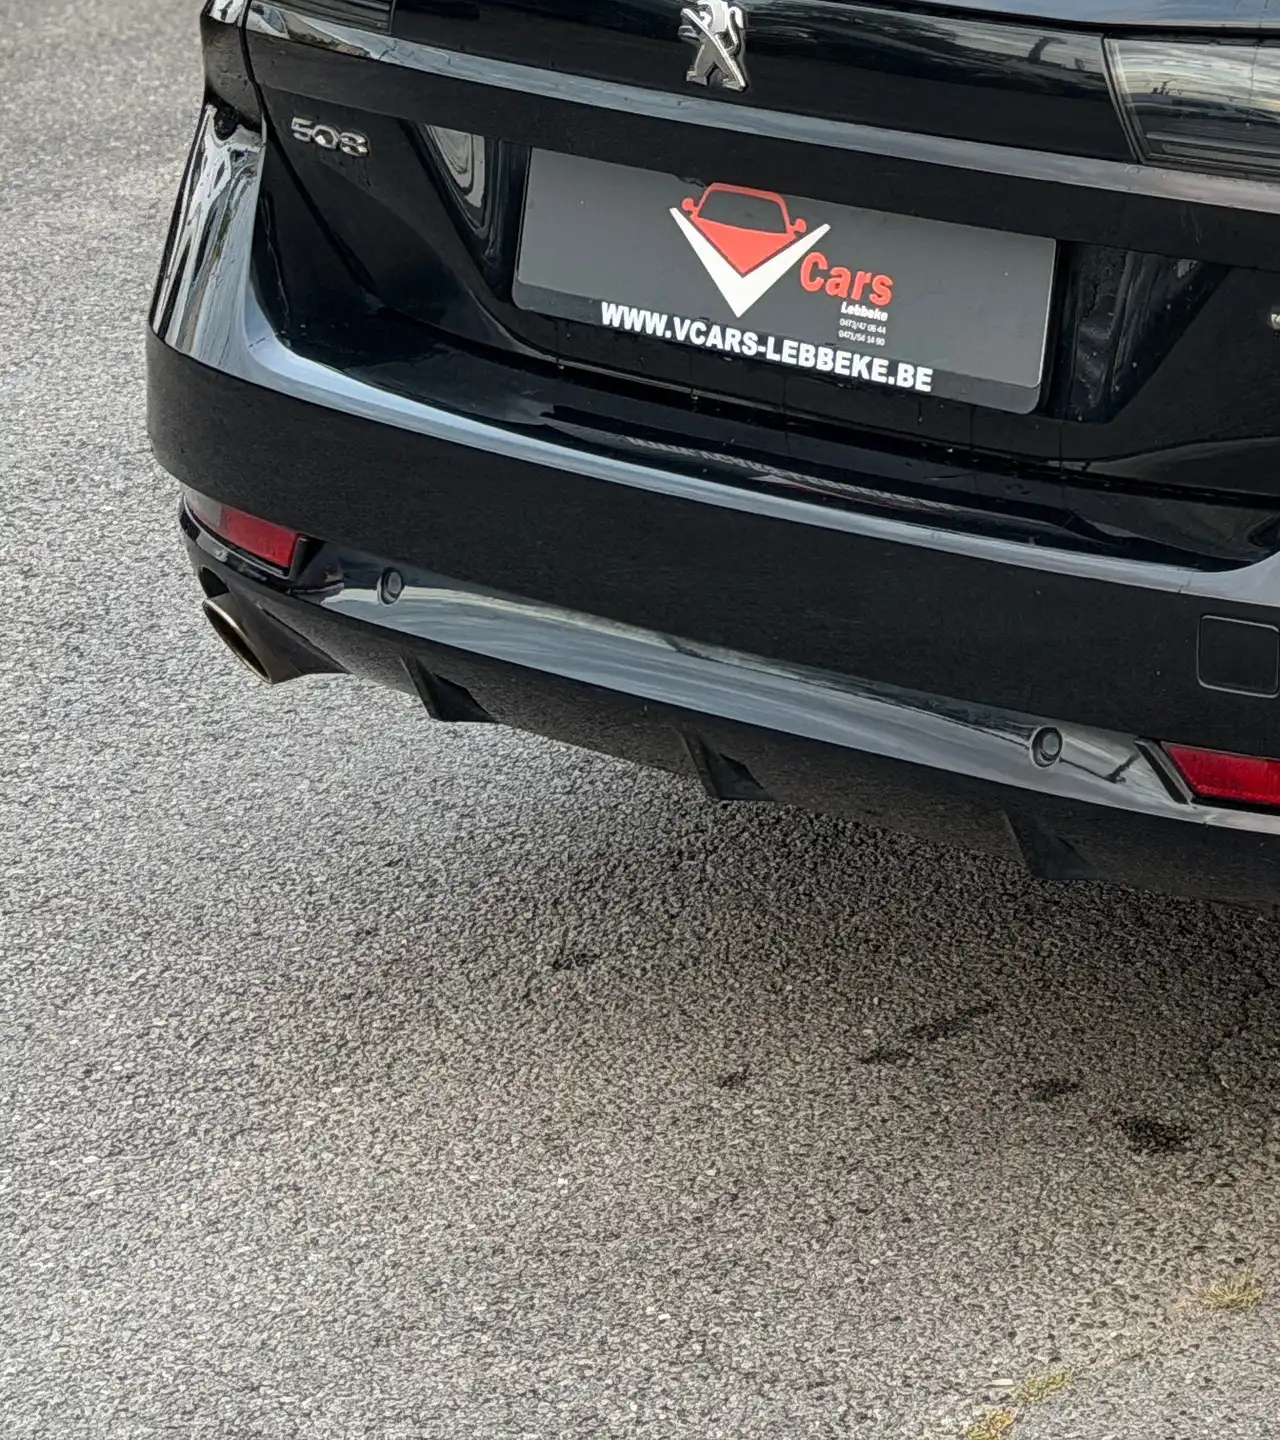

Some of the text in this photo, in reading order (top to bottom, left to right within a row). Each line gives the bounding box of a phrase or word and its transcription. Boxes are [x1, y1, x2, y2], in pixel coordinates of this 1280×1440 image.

[291, 116, 368, 157] 508
[800, 251, 894, 306] Cars
[601, 301, 933, 393] WWW.VCARS-LEBBEKE.BE
